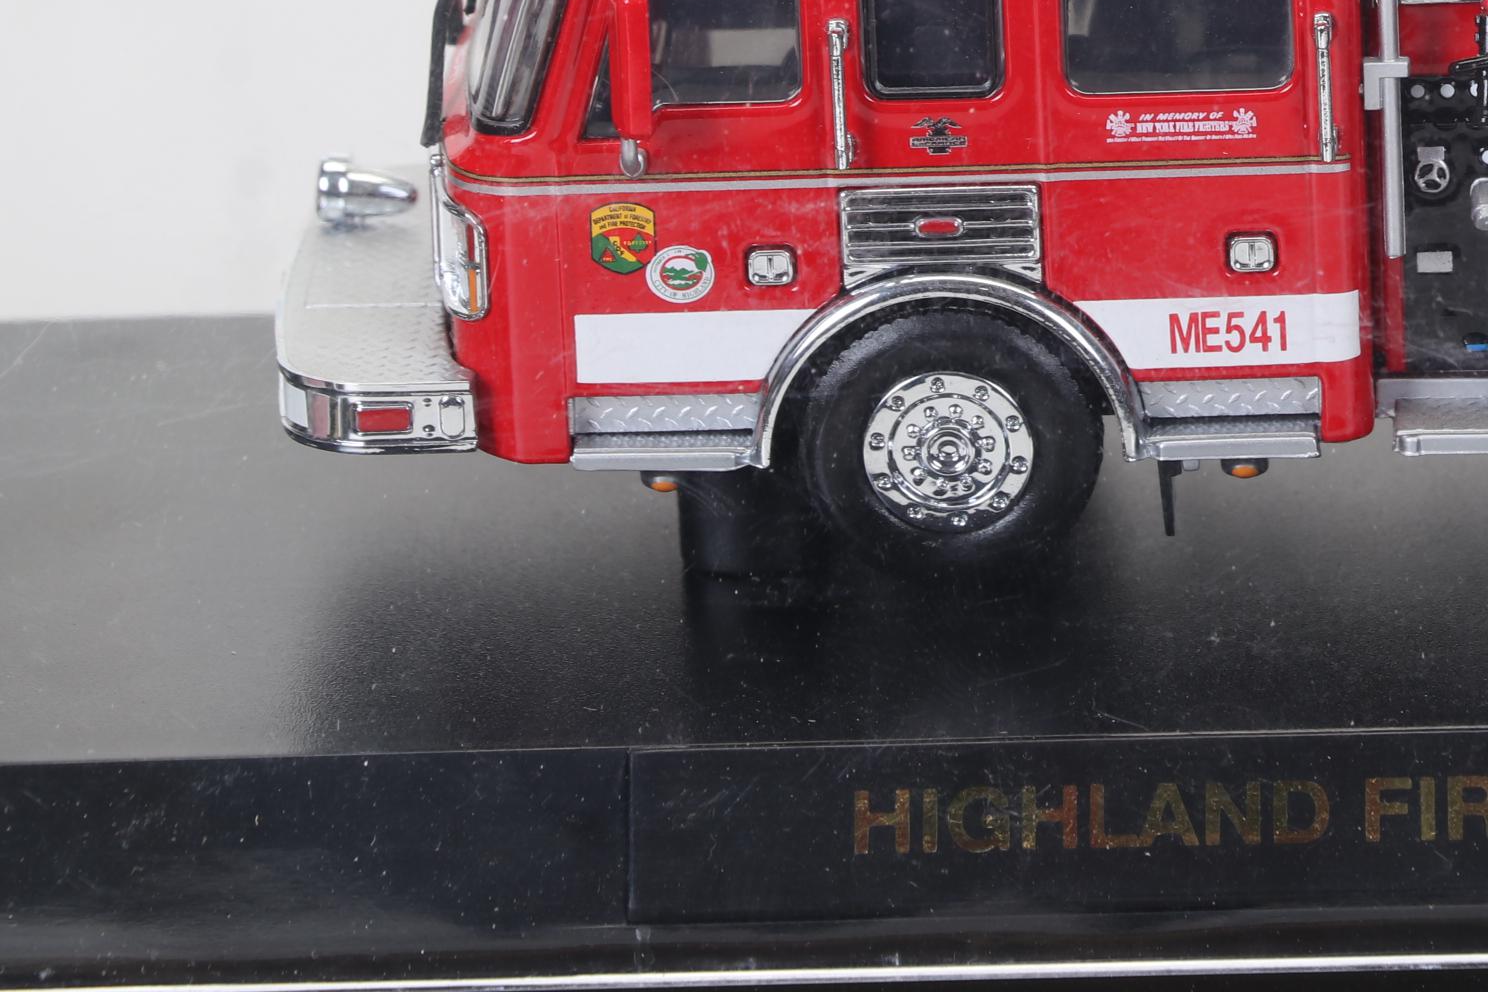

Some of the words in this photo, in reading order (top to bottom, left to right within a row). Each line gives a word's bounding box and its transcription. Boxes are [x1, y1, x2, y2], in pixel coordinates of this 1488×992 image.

[1139, 113, 1154, 121] IN
[1156, 112, 1207, 121] MEMORY
[1209, 111, 1224, 120] OF
[1155, 122, 1175, 133] YORK
[1168, 310, 1288, 354] ME541
[853, 780, 1330, 855] HIGHLAND
